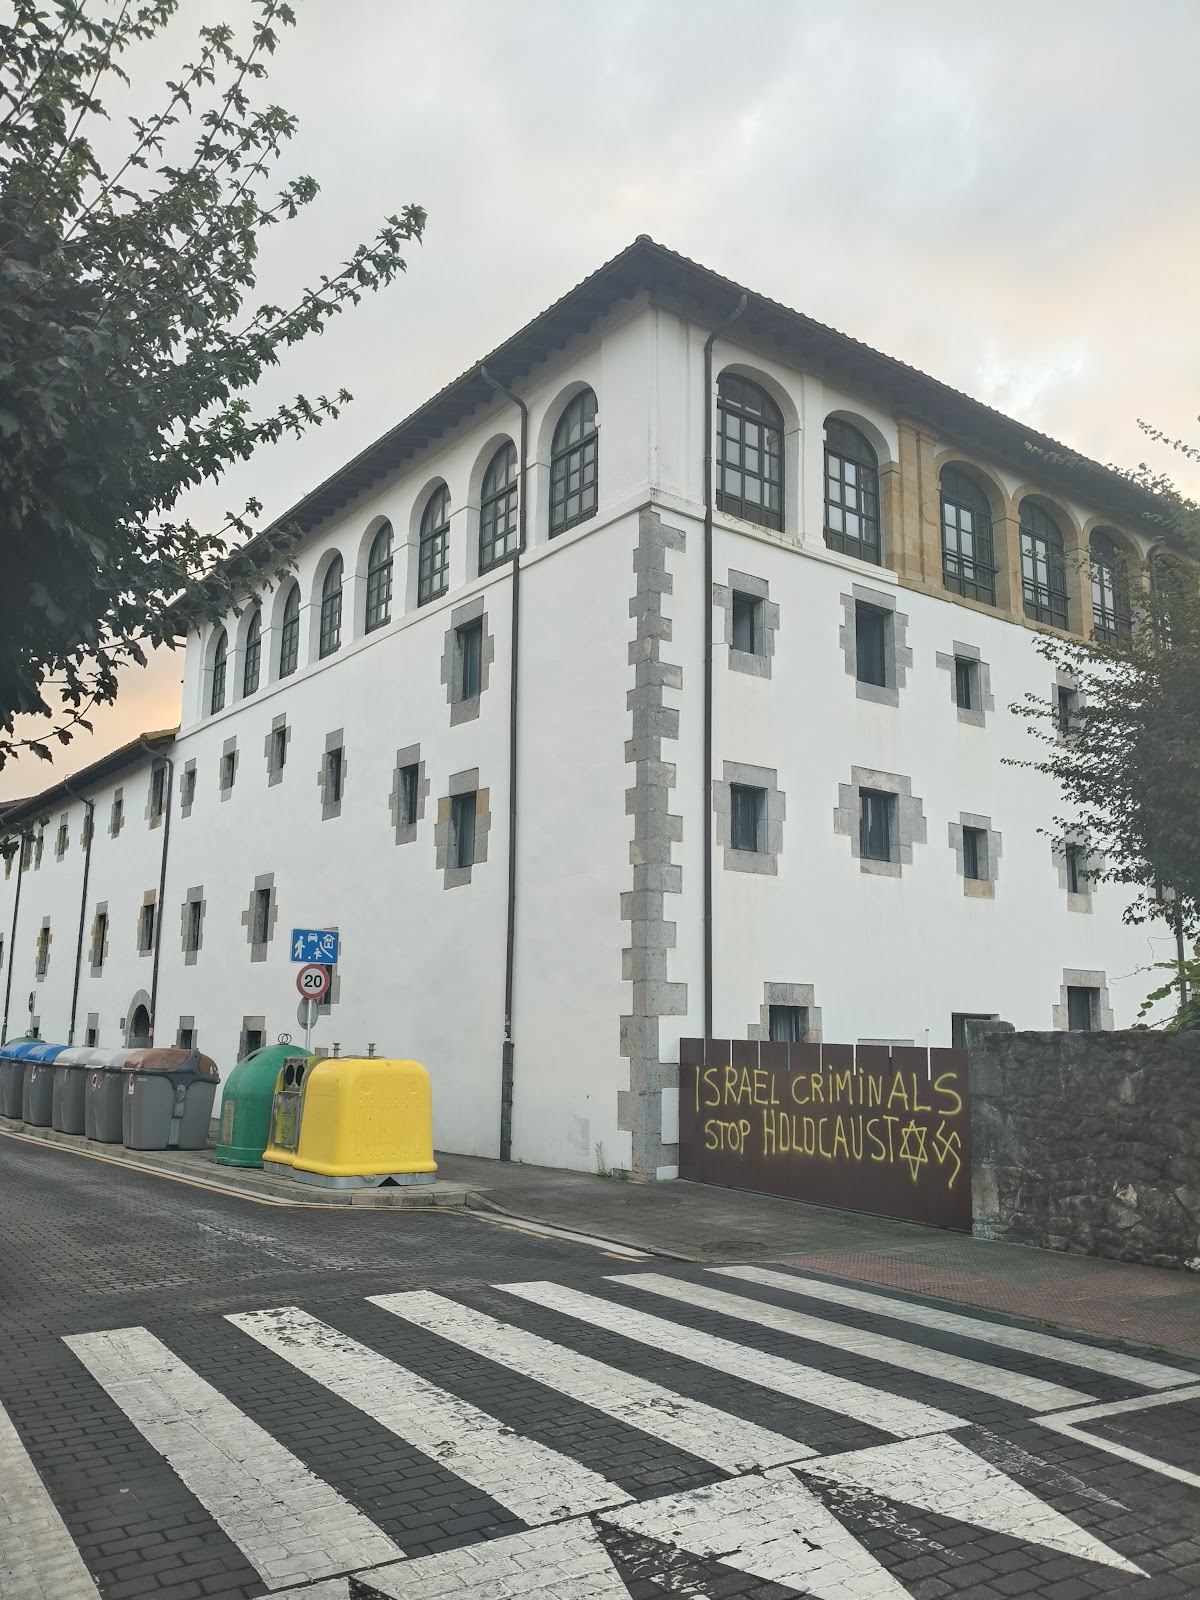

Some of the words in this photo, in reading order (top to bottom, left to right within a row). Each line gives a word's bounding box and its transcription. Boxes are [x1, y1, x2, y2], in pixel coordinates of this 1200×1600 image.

[304, 975, 322, 988] 20
[695, 1066, 780, 1112] ISRAEL
[704, 1119, 751, 1154] STOP
[763, 1109, 899, 1163] HOLOCAUST
